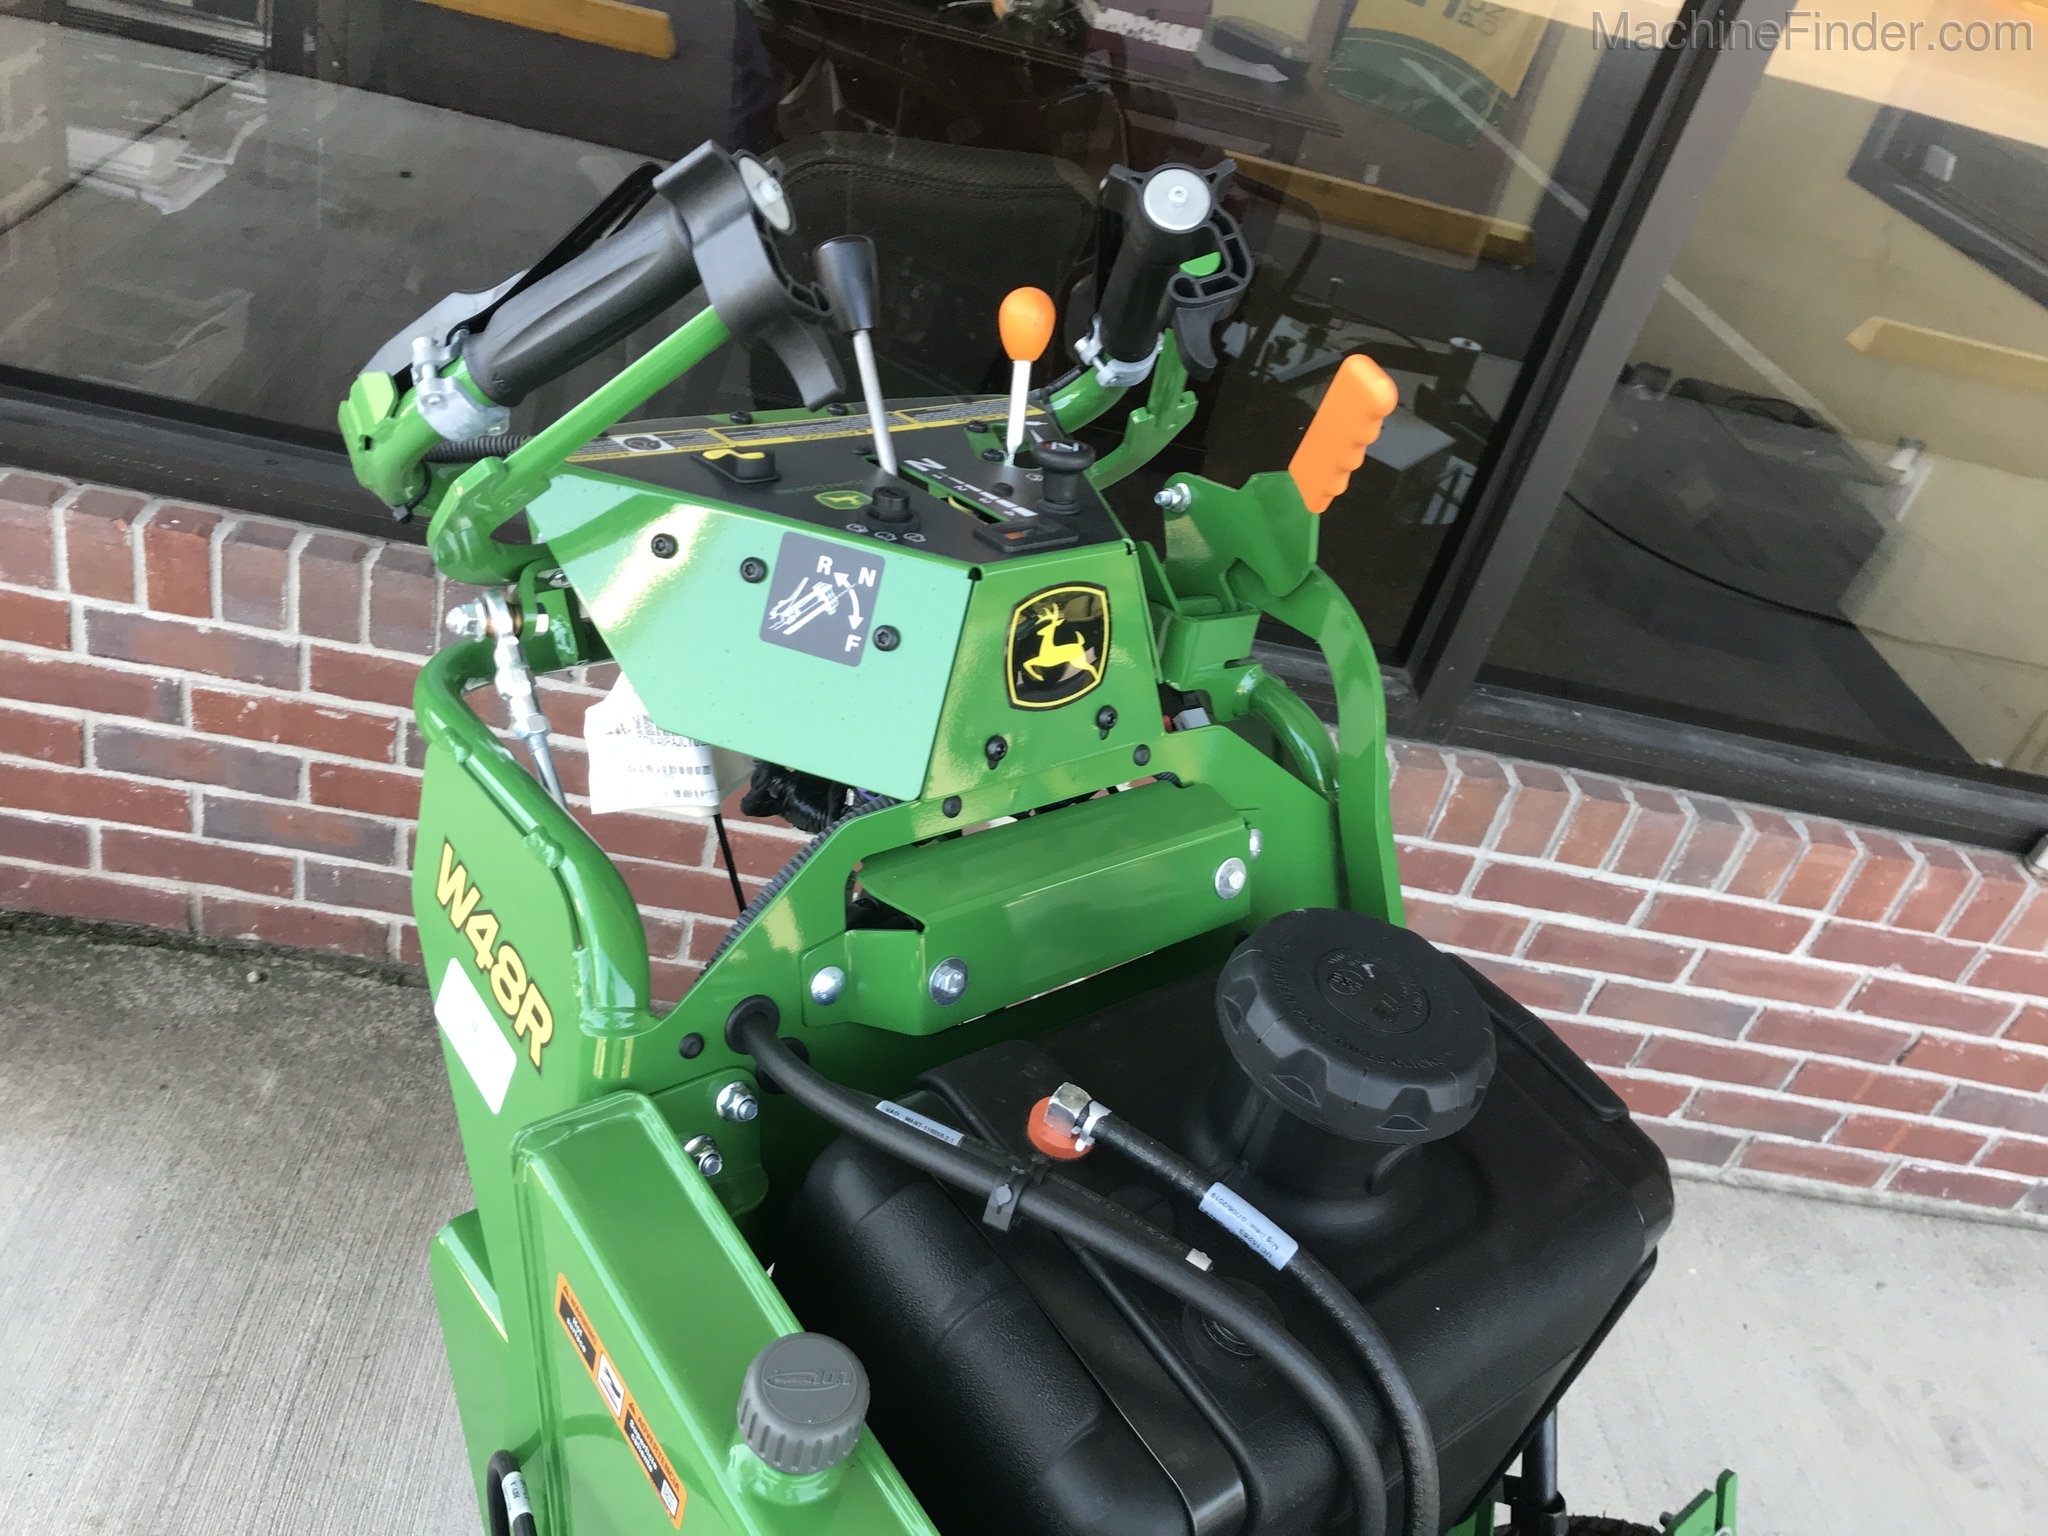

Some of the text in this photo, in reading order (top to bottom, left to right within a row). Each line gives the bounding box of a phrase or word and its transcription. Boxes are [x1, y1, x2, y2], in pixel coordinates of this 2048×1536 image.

[903, 457, 948, 472] N
[816, 555, 833, 574] R
[858, 568, 878, 586] N
[845, 634, 863, 653] F
[435, 840, 554, 1072] W48R
[569, 1294, 598, 1347] WARNING
[626, 1418, 660, 1471] Superficie
[628, 1432, 654, 1474] caliente
[635, 1417, 680, 1493] ADVERTENCIA
